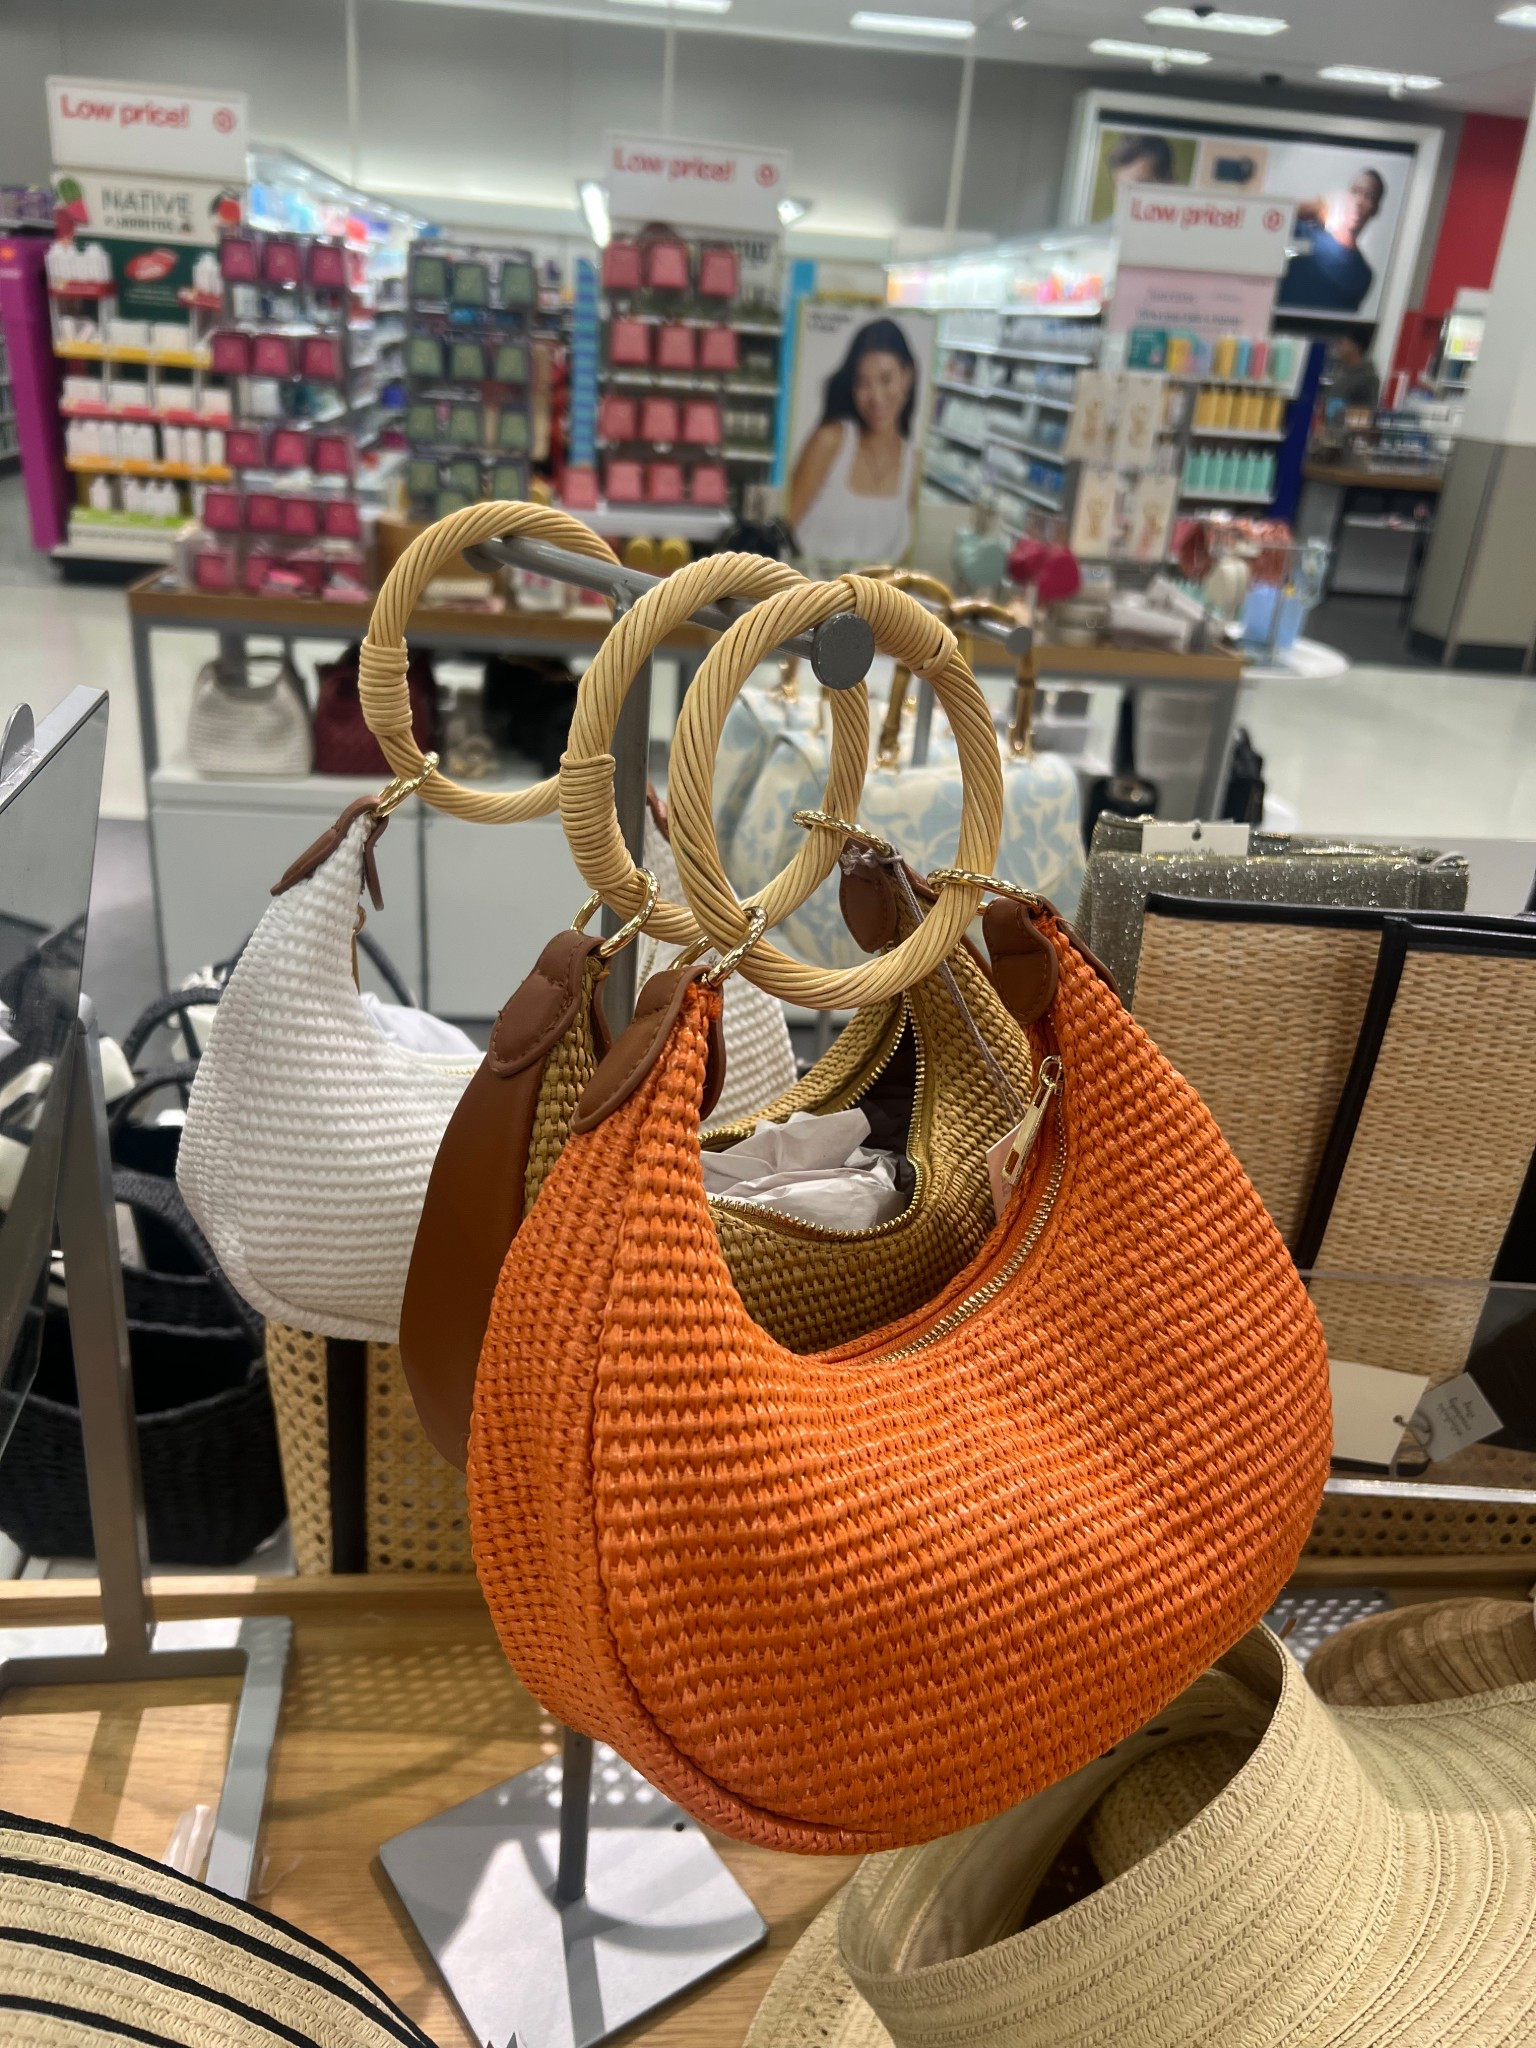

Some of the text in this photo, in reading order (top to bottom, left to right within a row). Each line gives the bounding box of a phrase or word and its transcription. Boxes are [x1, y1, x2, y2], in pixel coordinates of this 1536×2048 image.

[60, 95, 190, 129] Low price!
[613, 147, 736, 182] Low price!
[101, 187, 194, 215] NATIVE
[1130, 198, 1244, 229] Low price!
